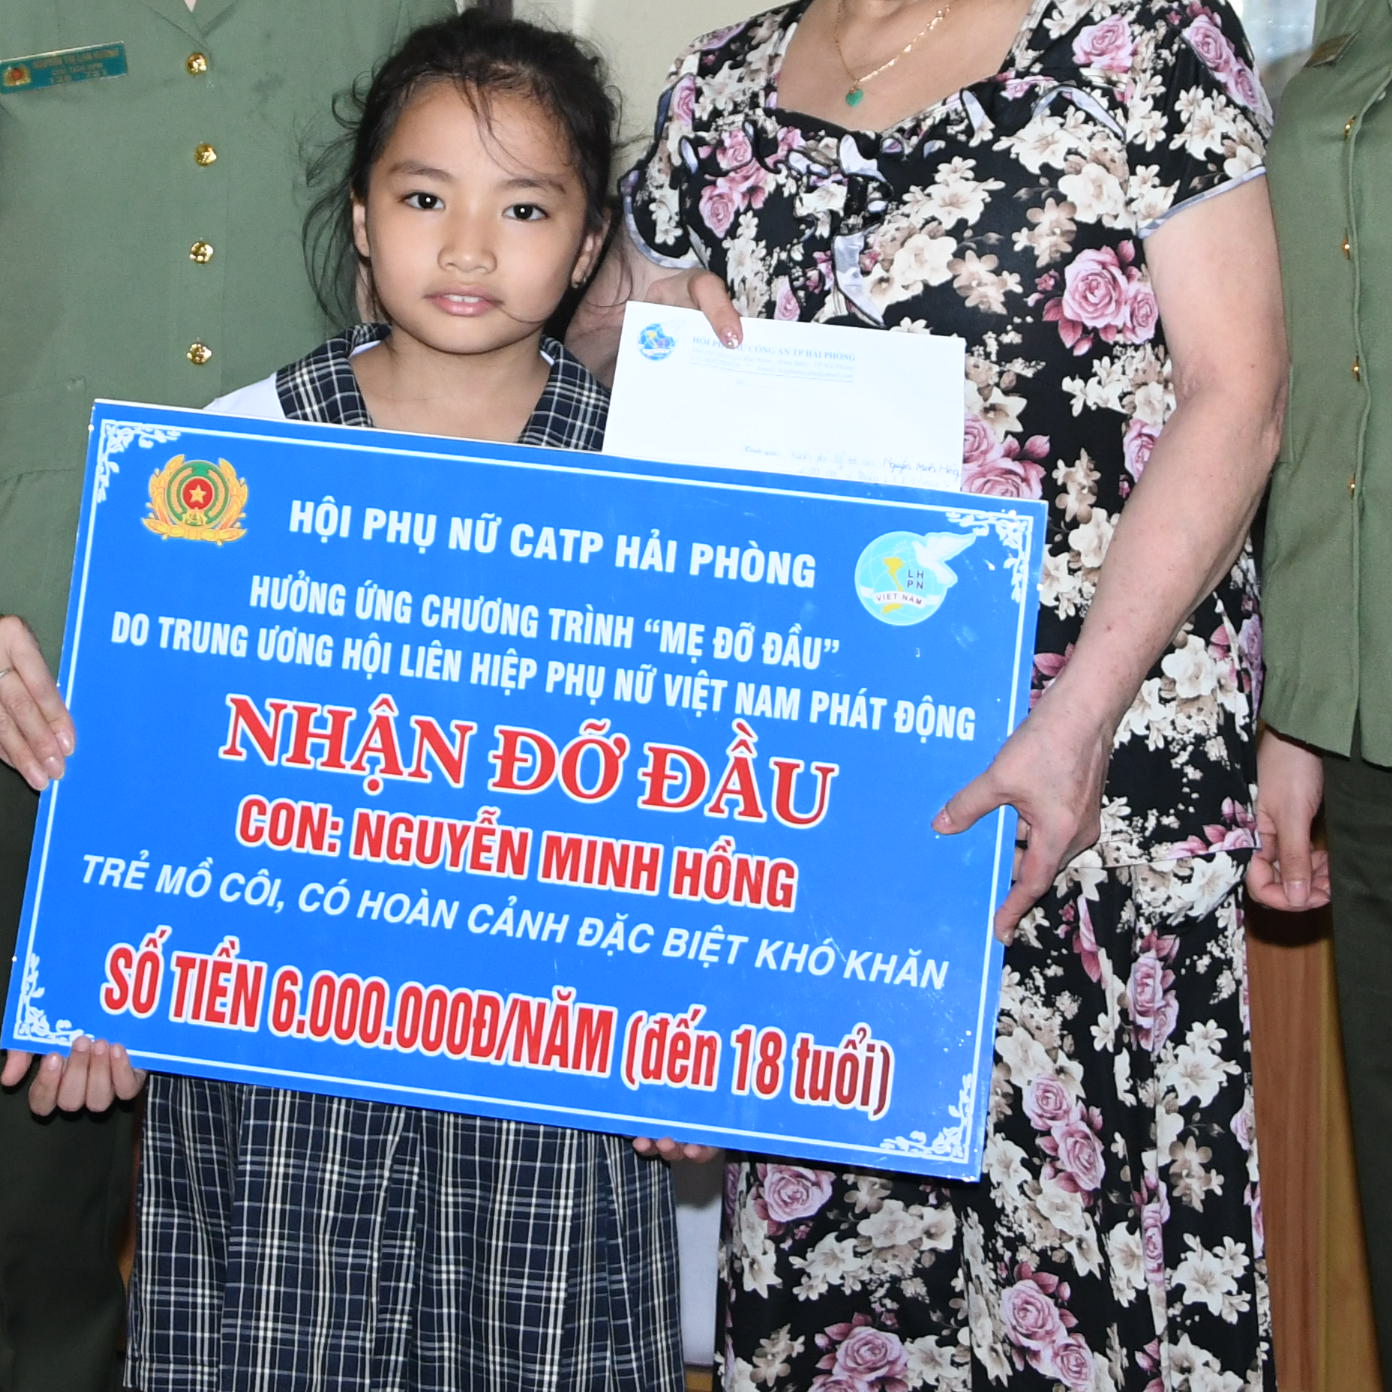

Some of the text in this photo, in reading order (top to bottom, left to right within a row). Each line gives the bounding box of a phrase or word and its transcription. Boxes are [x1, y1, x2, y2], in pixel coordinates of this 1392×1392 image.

[289, 495, 816, 588] HỘI PHỤ NỮ CATP HẢI PHÒNG
[111, 611, 976, 744] DO TRUNG ƯƠNG HỘI LIÊN HIỆP PHỤ NỮ VIỆT NAM PHÁT ĐỘNG
[250, 570, 840, 670] HƯỞNG ỨNG CHƯƠNG TRÌNH “MẸ ĐỠ ĐẦU”
[221, 696, 837, 827] NHẬN ĐỠ ĐẦU
[238, 797, 797, 910] CON: NGUYỄN MINH HỒNG
[83, 849, 949, 990] TRẺ MỒ CÔI, CÓ HOÀN CẢNH ĐẶC BIỆT KHÓ KHĂN
[102, 928, 892, 1116] SỐ TIỀN 6.000.000Đ/NĂM (đến 18 tuổi)
